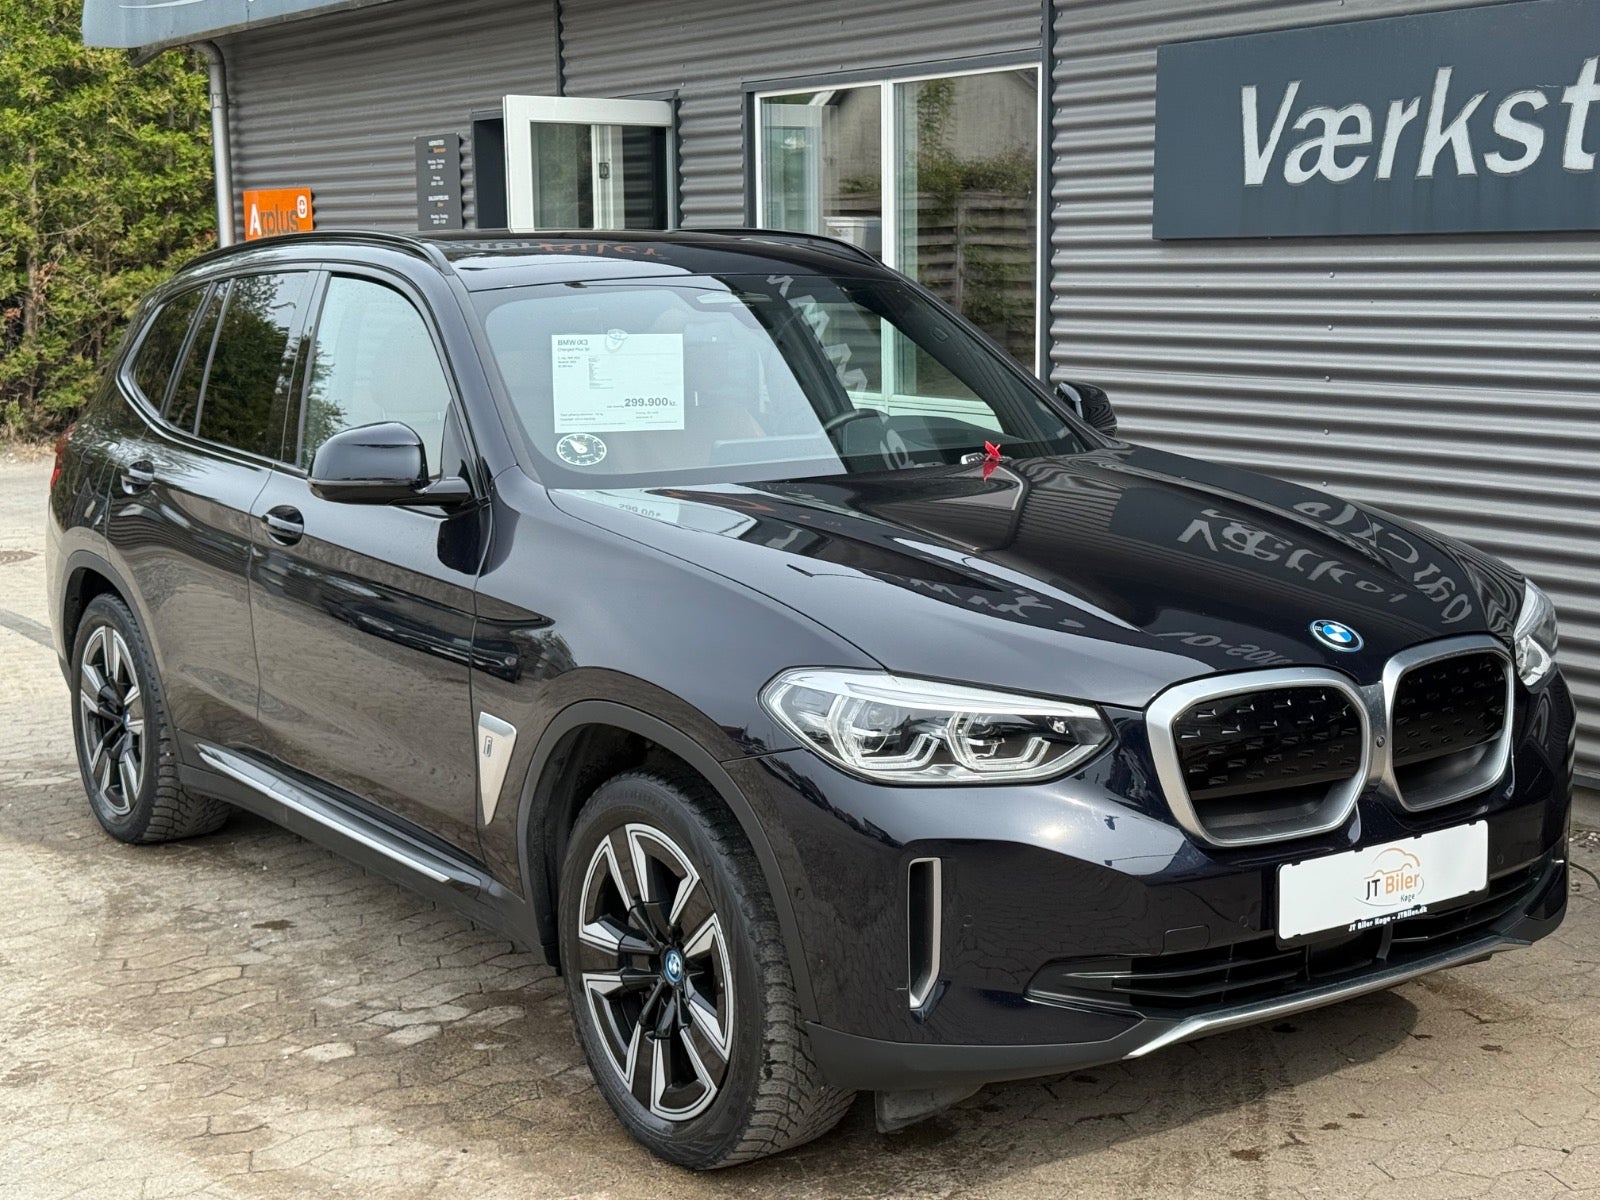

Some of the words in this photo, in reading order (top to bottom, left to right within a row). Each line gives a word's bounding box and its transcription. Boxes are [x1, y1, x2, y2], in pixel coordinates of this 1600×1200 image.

[624, 397, 669, 407] 299.900
[1366, 879, 1380, 900] JT
[1385, 873, 1420, 894] Biler
[1348, 923, 1357, 932] JT
[1357, 920, 1374, 930] Biler
